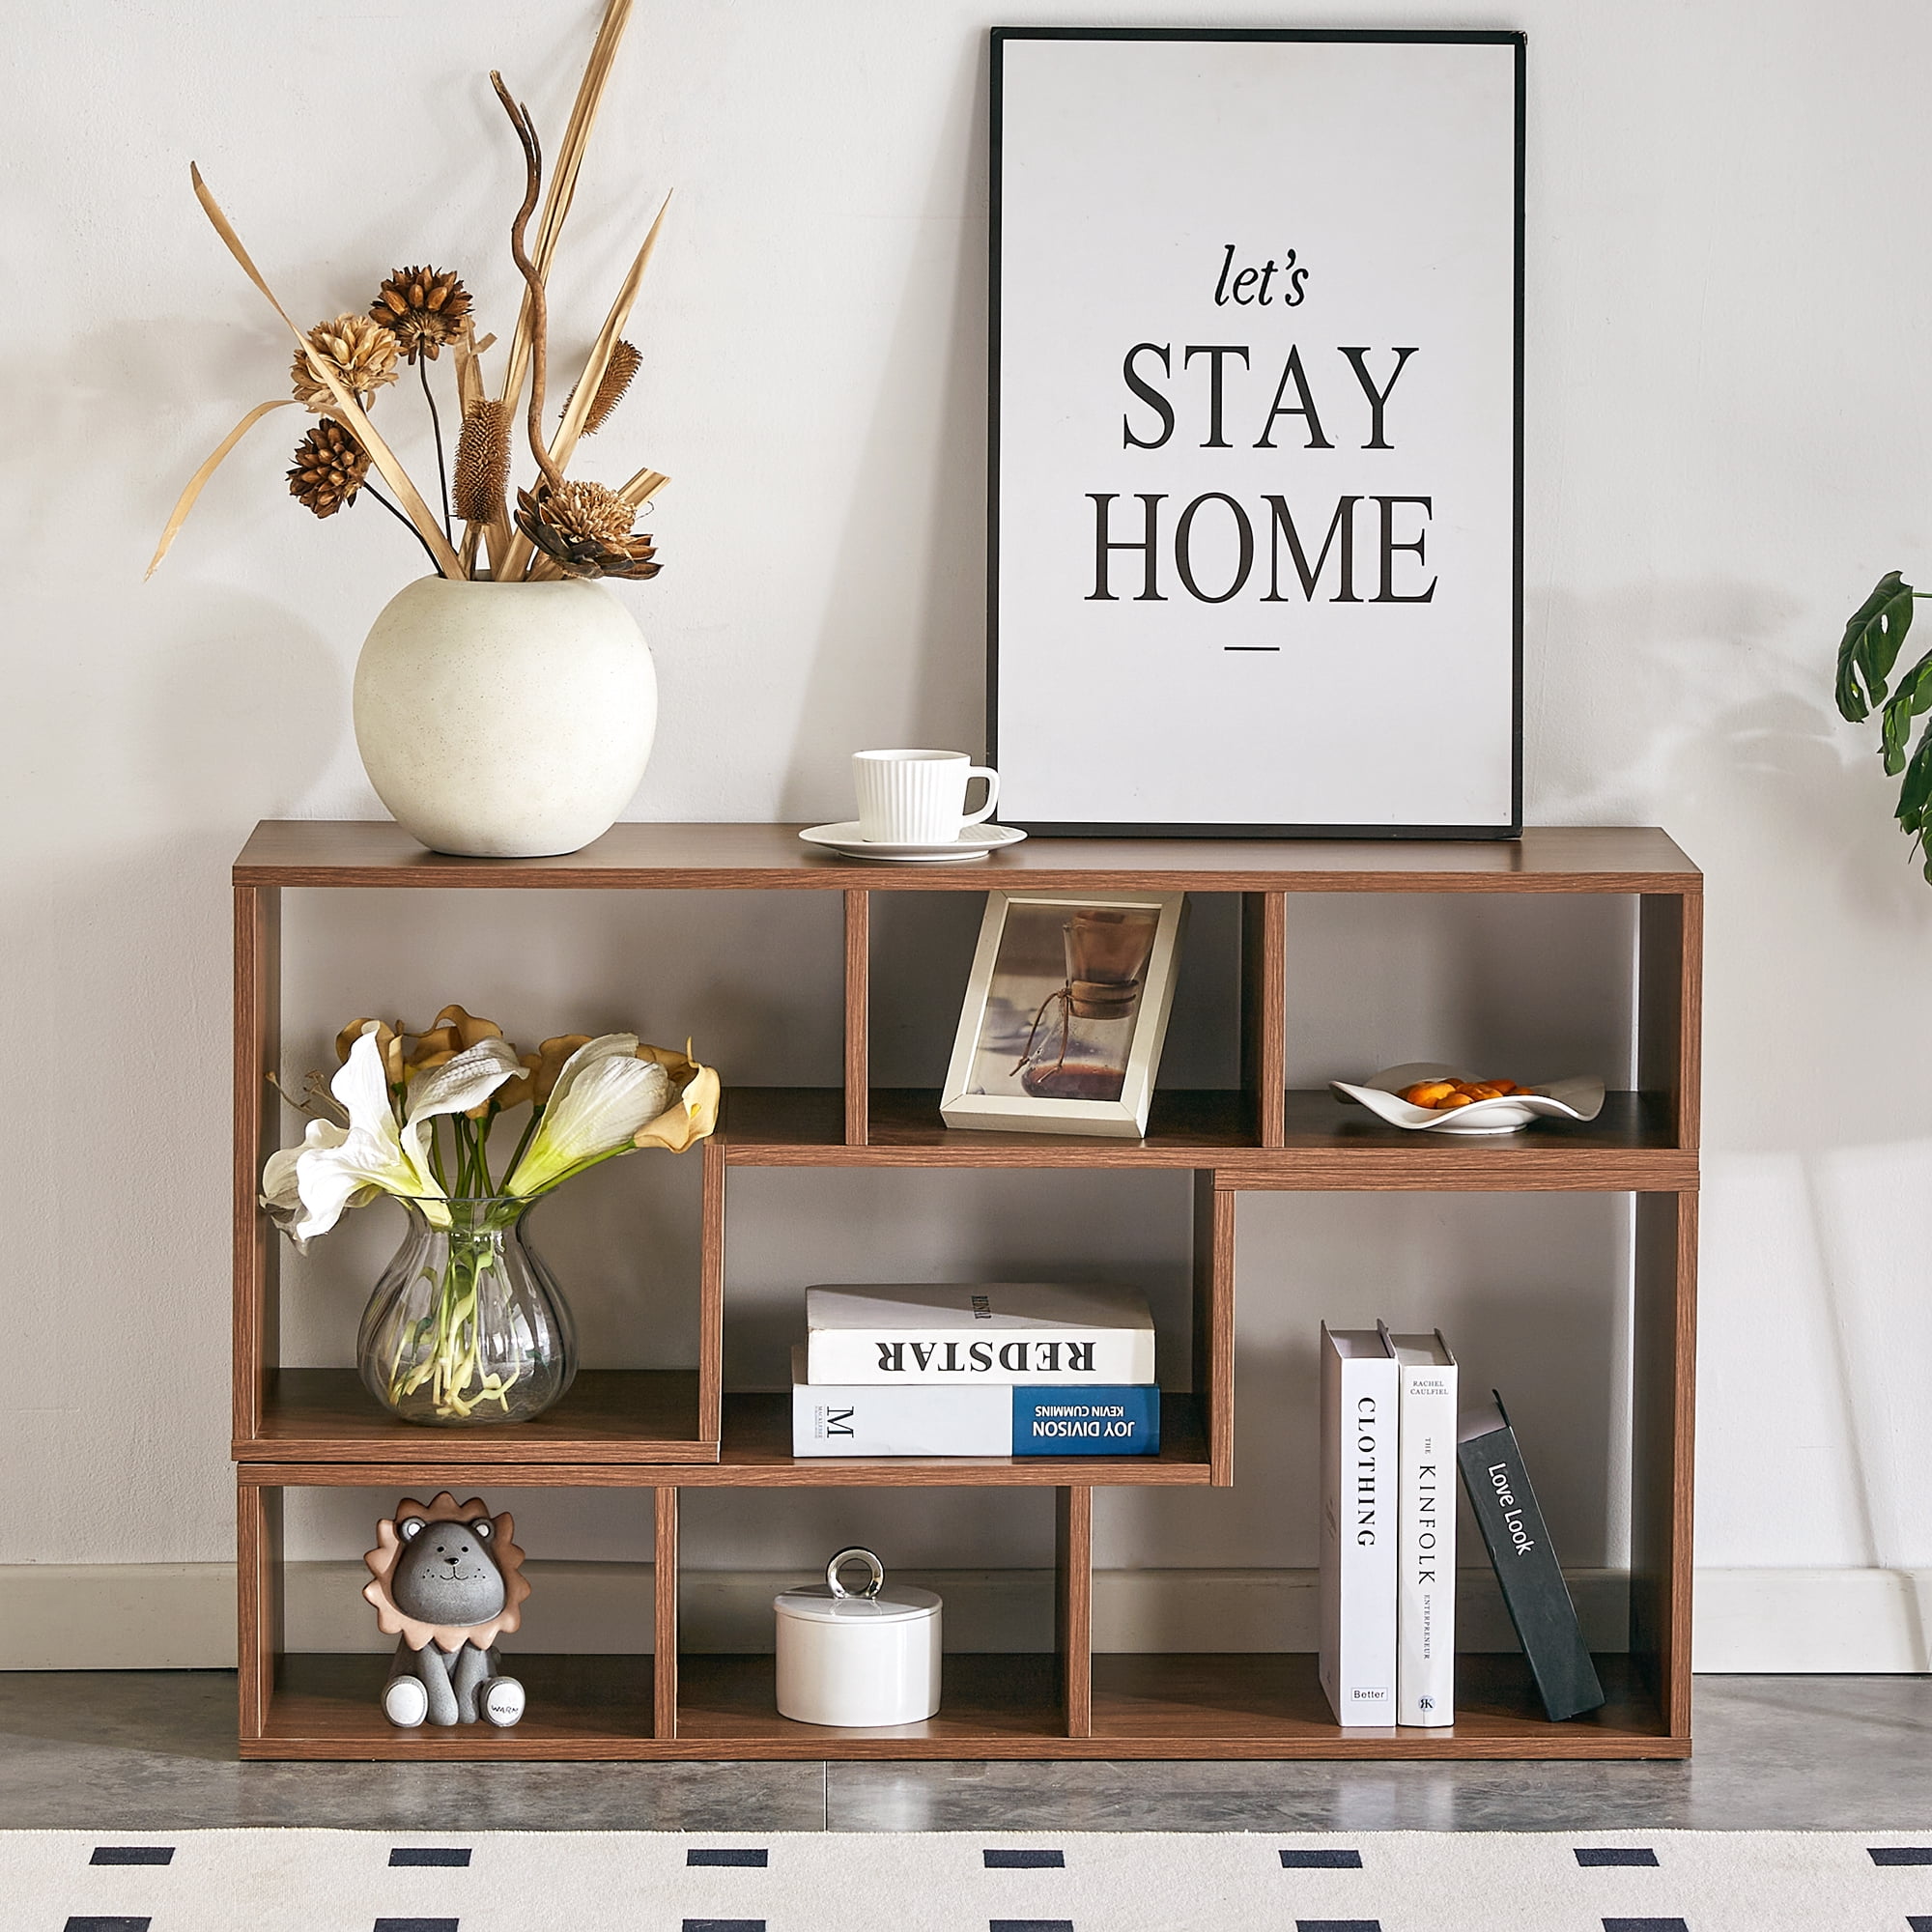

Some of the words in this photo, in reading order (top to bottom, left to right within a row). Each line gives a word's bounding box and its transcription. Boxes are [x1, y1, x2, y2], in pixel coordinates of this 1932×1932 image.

[1122, 342, 1420, 450] STAY
[1083, 492, 1438, 604] HOME
[874, 1341, 1097, 1373] REDSTAR
[826, 1406, 855, 1438] M
[1035, 1406, 1090, 1417] CUMMINS
[1091, 1406, 1124, 1417] KEVIN
[1032, 1421, 1100, 1437] DIVISON
[1103, 1421, 1136, 1437] JOY
[1357, 1397, 1377, 1548] CLOTHING
[1418, 1464, 1436, 1585] KINFOLK
[1488, 1463, 1515, 1507] Love
[1504, 1508, 1535, 1556] Look
[1353, 1690, 1384, 1699] Better
